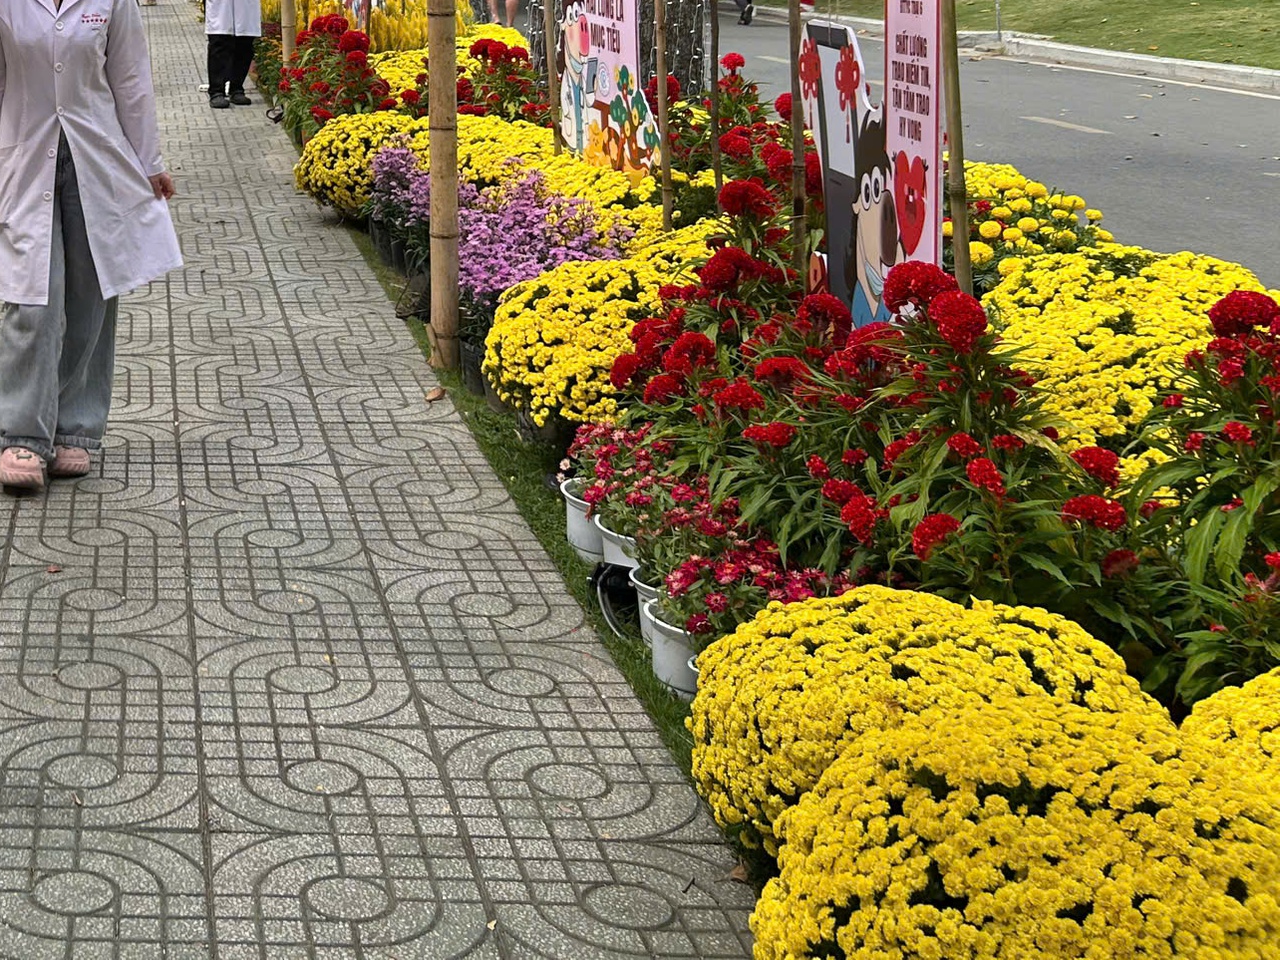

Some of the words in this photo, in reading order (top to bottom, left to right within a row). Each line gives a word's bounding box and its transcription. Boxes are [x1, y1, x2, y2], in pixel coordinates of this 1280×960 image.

[590, 23, 605, 54] MỤC
[606, 22, 620, 54] TIÊU
[895, 30, 908, 56] CHẤT
[909, 33, 928, 62] LƯỢNG
[891, 60, 905, 82] TRAO
[920, 64, 931, 90] TIN,
[892, 83, 902, 113] TẬN
[903, 85, 915, 114] TÂM
[915, 90, 930, 117] TRAO
[898, 116, 907, 138] HY
[907, 117, 922, 145] VỌNG
